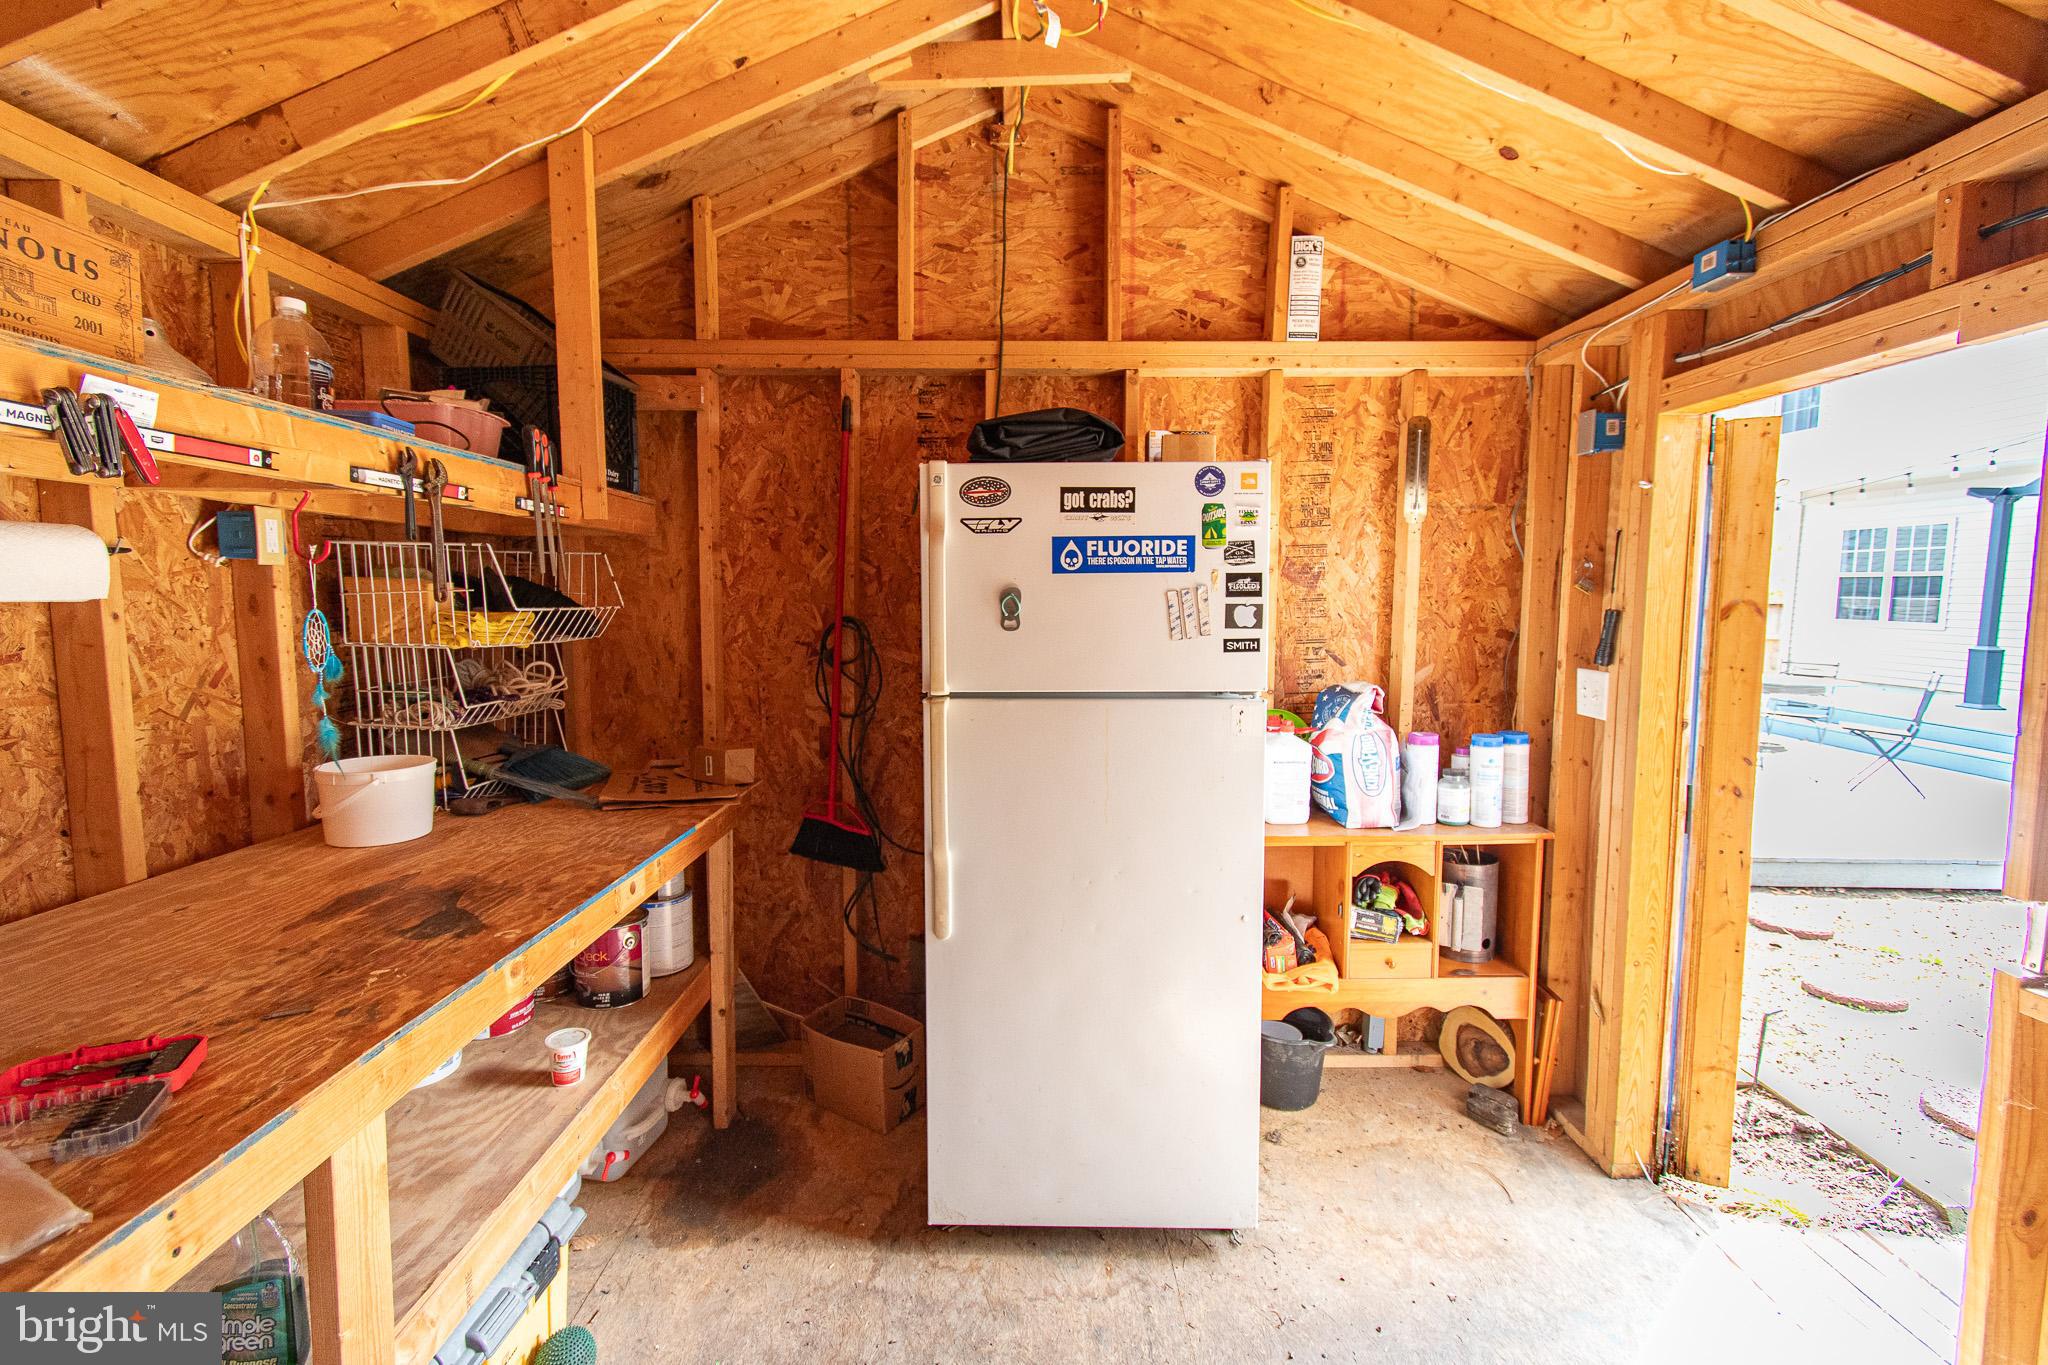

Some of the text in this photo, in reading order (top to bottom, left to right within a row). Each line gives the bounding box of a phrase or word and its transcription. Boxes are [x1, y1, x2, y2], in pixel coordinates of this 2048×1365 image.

[5, 217, 31, 233] EAU
[1294, 241, 1322, 252] DICK'S
[71, 288, 101, 307] CRD
[73, 316, 104, 336] 2001
[1063, 490, 1133, 510] got crabs?
[1202, 508, 1226, 522] OUTSIDE
[1086, 540, 1187, 556] FLUORIDE
[1087, 556, 1187, 565] THERE IS POISON IN THE TAP WATER
[1226, 641, 1258, 650] SMITH
